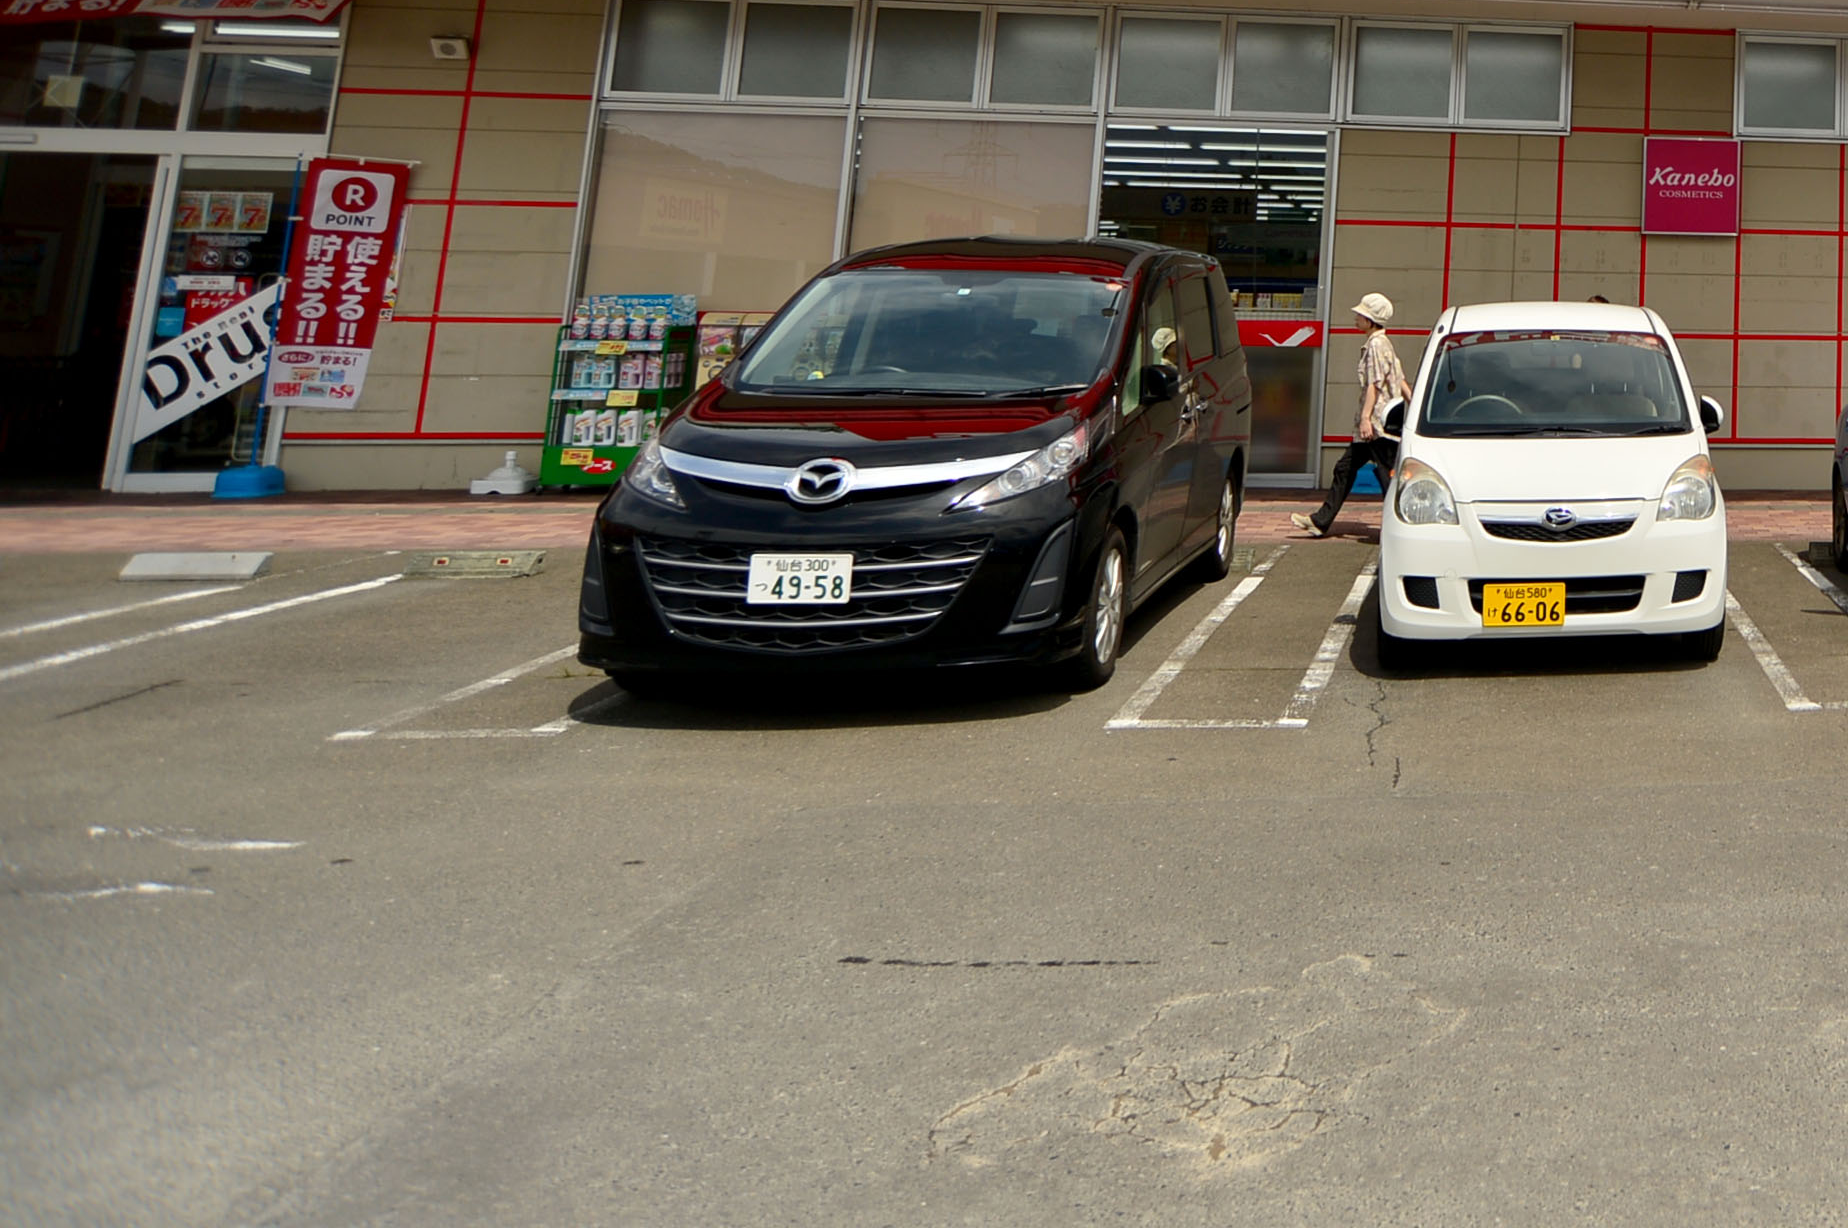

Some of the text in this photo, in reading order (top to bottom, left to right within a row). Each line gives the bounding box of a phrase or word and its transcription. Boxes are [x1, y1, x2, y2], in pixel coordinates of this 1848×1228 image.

[1649, 166, 1735, 187] Kanebo
[345, 184, 365, 207] R
[1659, 189, 1724, 199] COSMETICS
[1191, 197, 1251, 214] お会計
[325, 213, 375, 227] POINT
[191, 298, 234, 309] ドラッグ
[181, 329, 211, 350] The
[771, 575, 844, 600] 49-58
[1501, 601, 1560, 622] 66-06
